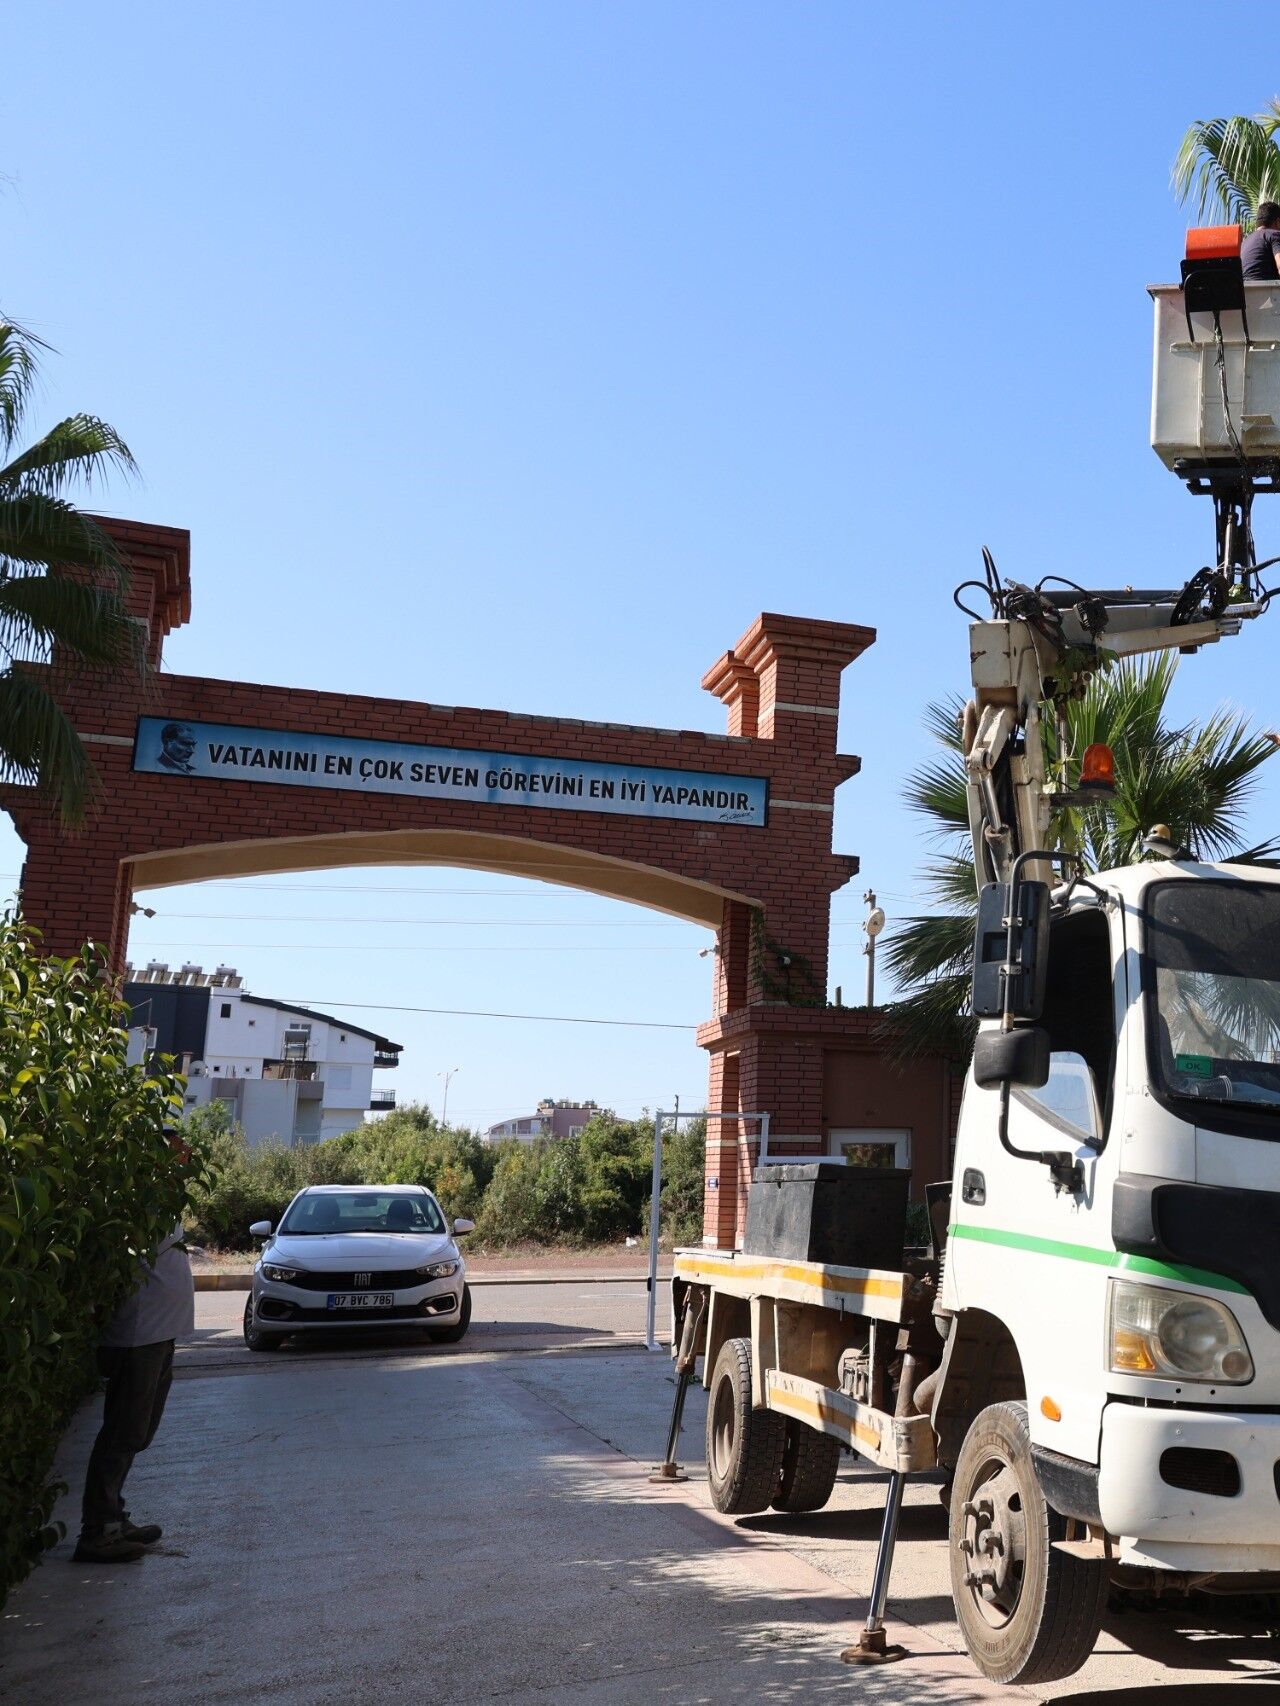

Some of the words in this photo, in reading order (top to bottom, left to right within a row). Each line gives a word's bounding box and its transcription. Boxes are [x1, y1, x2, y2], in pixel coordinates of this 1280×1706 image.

[208, 744, 318, 773] VATANINI
[324, 755, 353, 776] EN
[359, 758, 404, 782] ÇOK
[410, 763, 479, 787] SEVEN
[485, 768, 584, 797] GÖREVİNİ
[590, 779, 615, 799] EN
[621, 778, 646, 802] İYİ
[652, 784, 755, 811] YAPANDIR.
[354, 1273, 372, 1286] FIAT
[335, 1296, 347, 1306] 07
[351, 1295, 368, 1306] BVC
